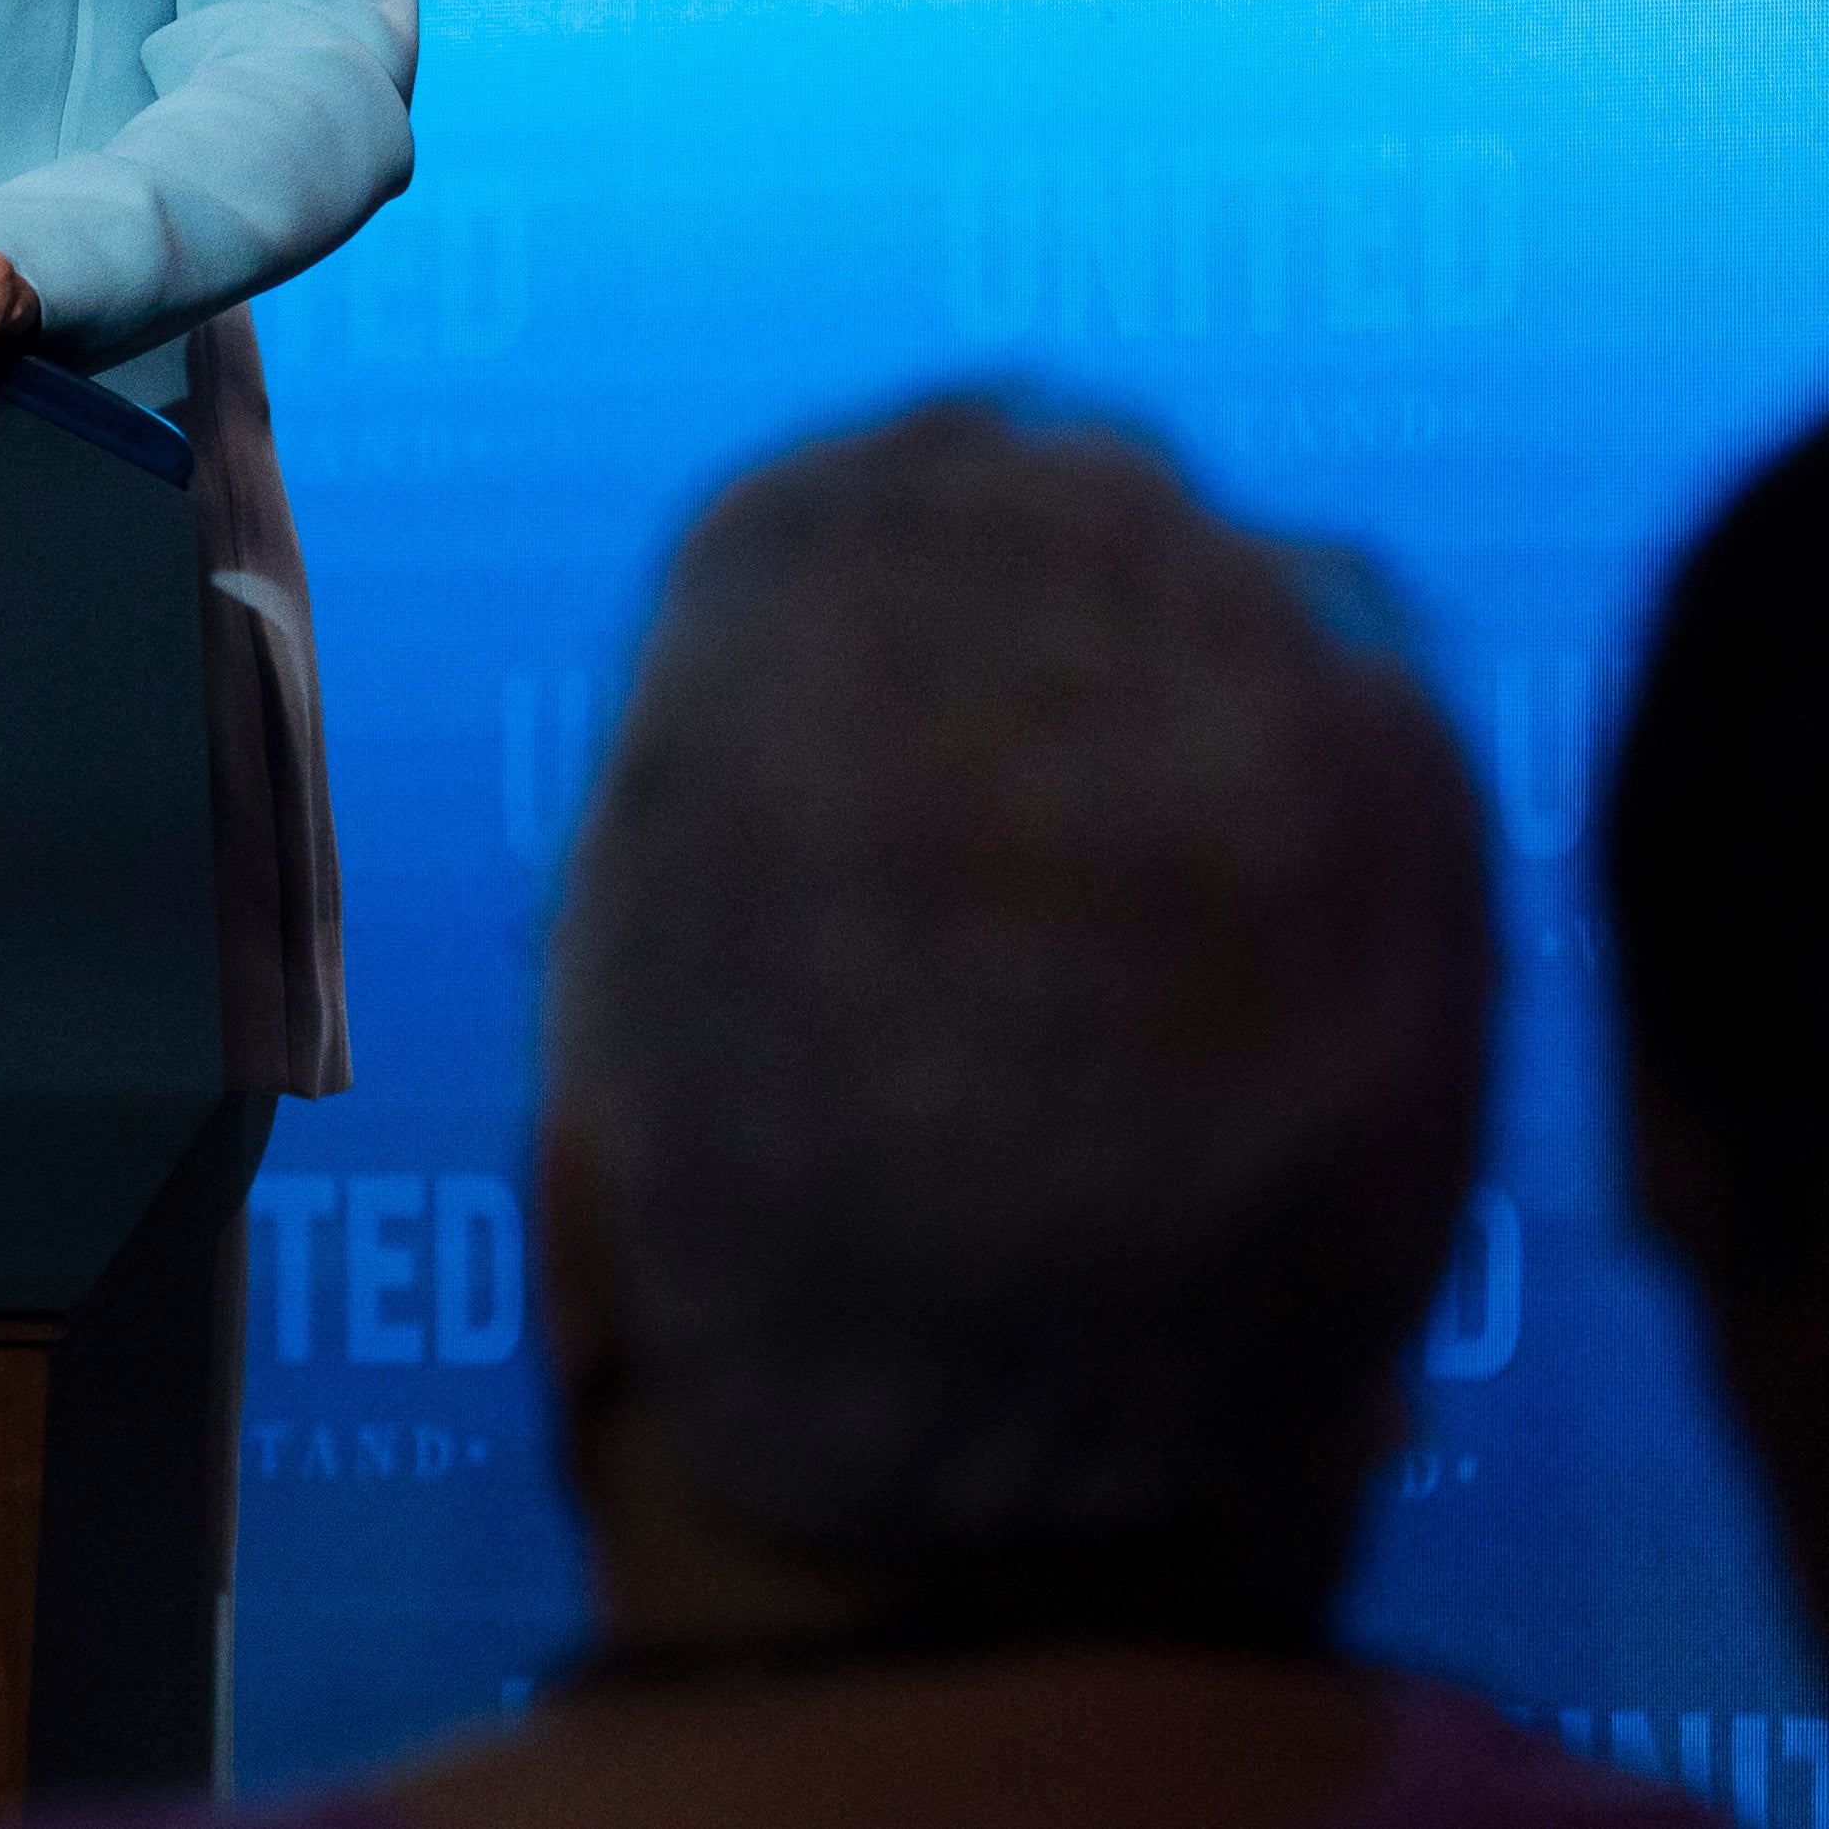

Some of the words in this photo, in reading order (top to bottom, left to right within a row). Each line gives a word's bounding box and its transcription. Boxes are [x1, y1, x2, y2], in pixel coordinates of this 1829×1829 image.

[944, 133, 1516, 343] UNITED
[245, 1174, 524, 1364] TED
[245, 1423, 454, 1479] TAND
